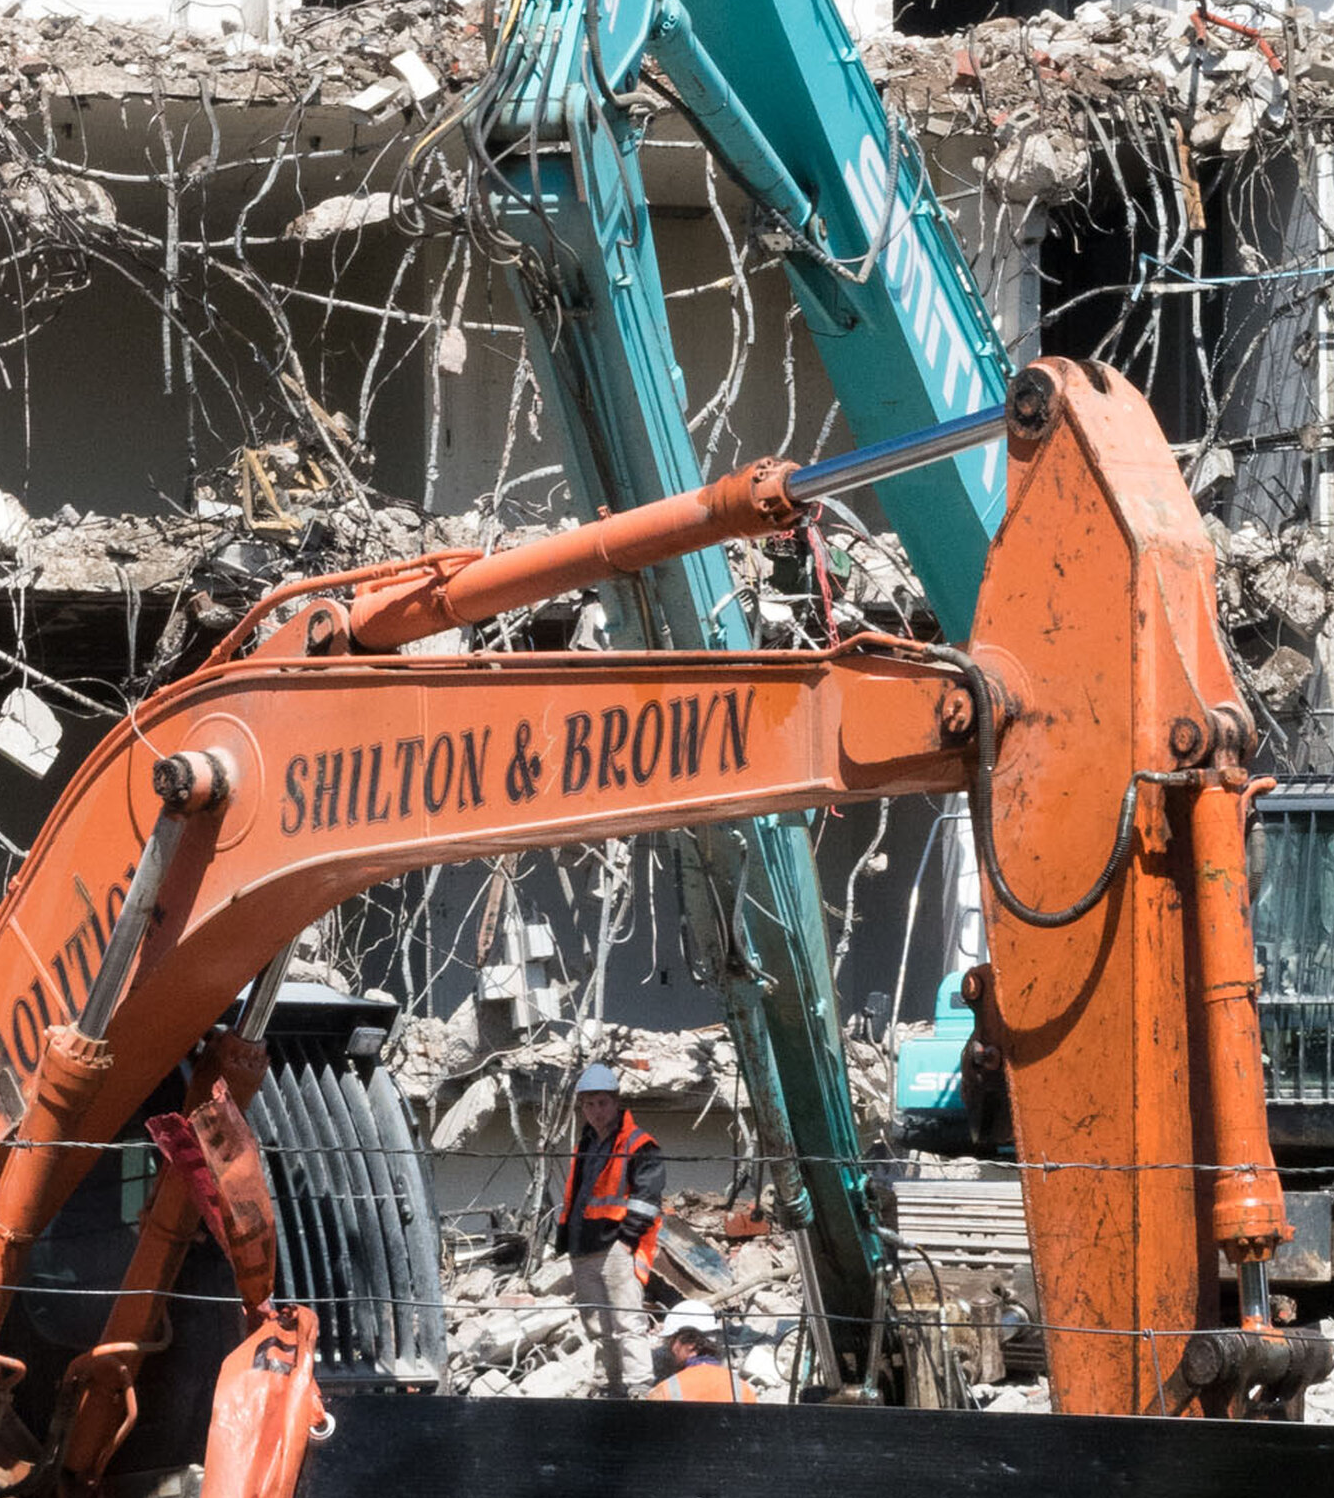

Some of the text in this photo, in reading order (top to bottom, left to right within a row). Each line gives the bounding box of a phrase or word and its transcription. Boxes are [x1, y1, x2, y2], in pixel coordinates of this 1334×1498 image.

[280, 684, 757, 836] SHILTON & BROWN
